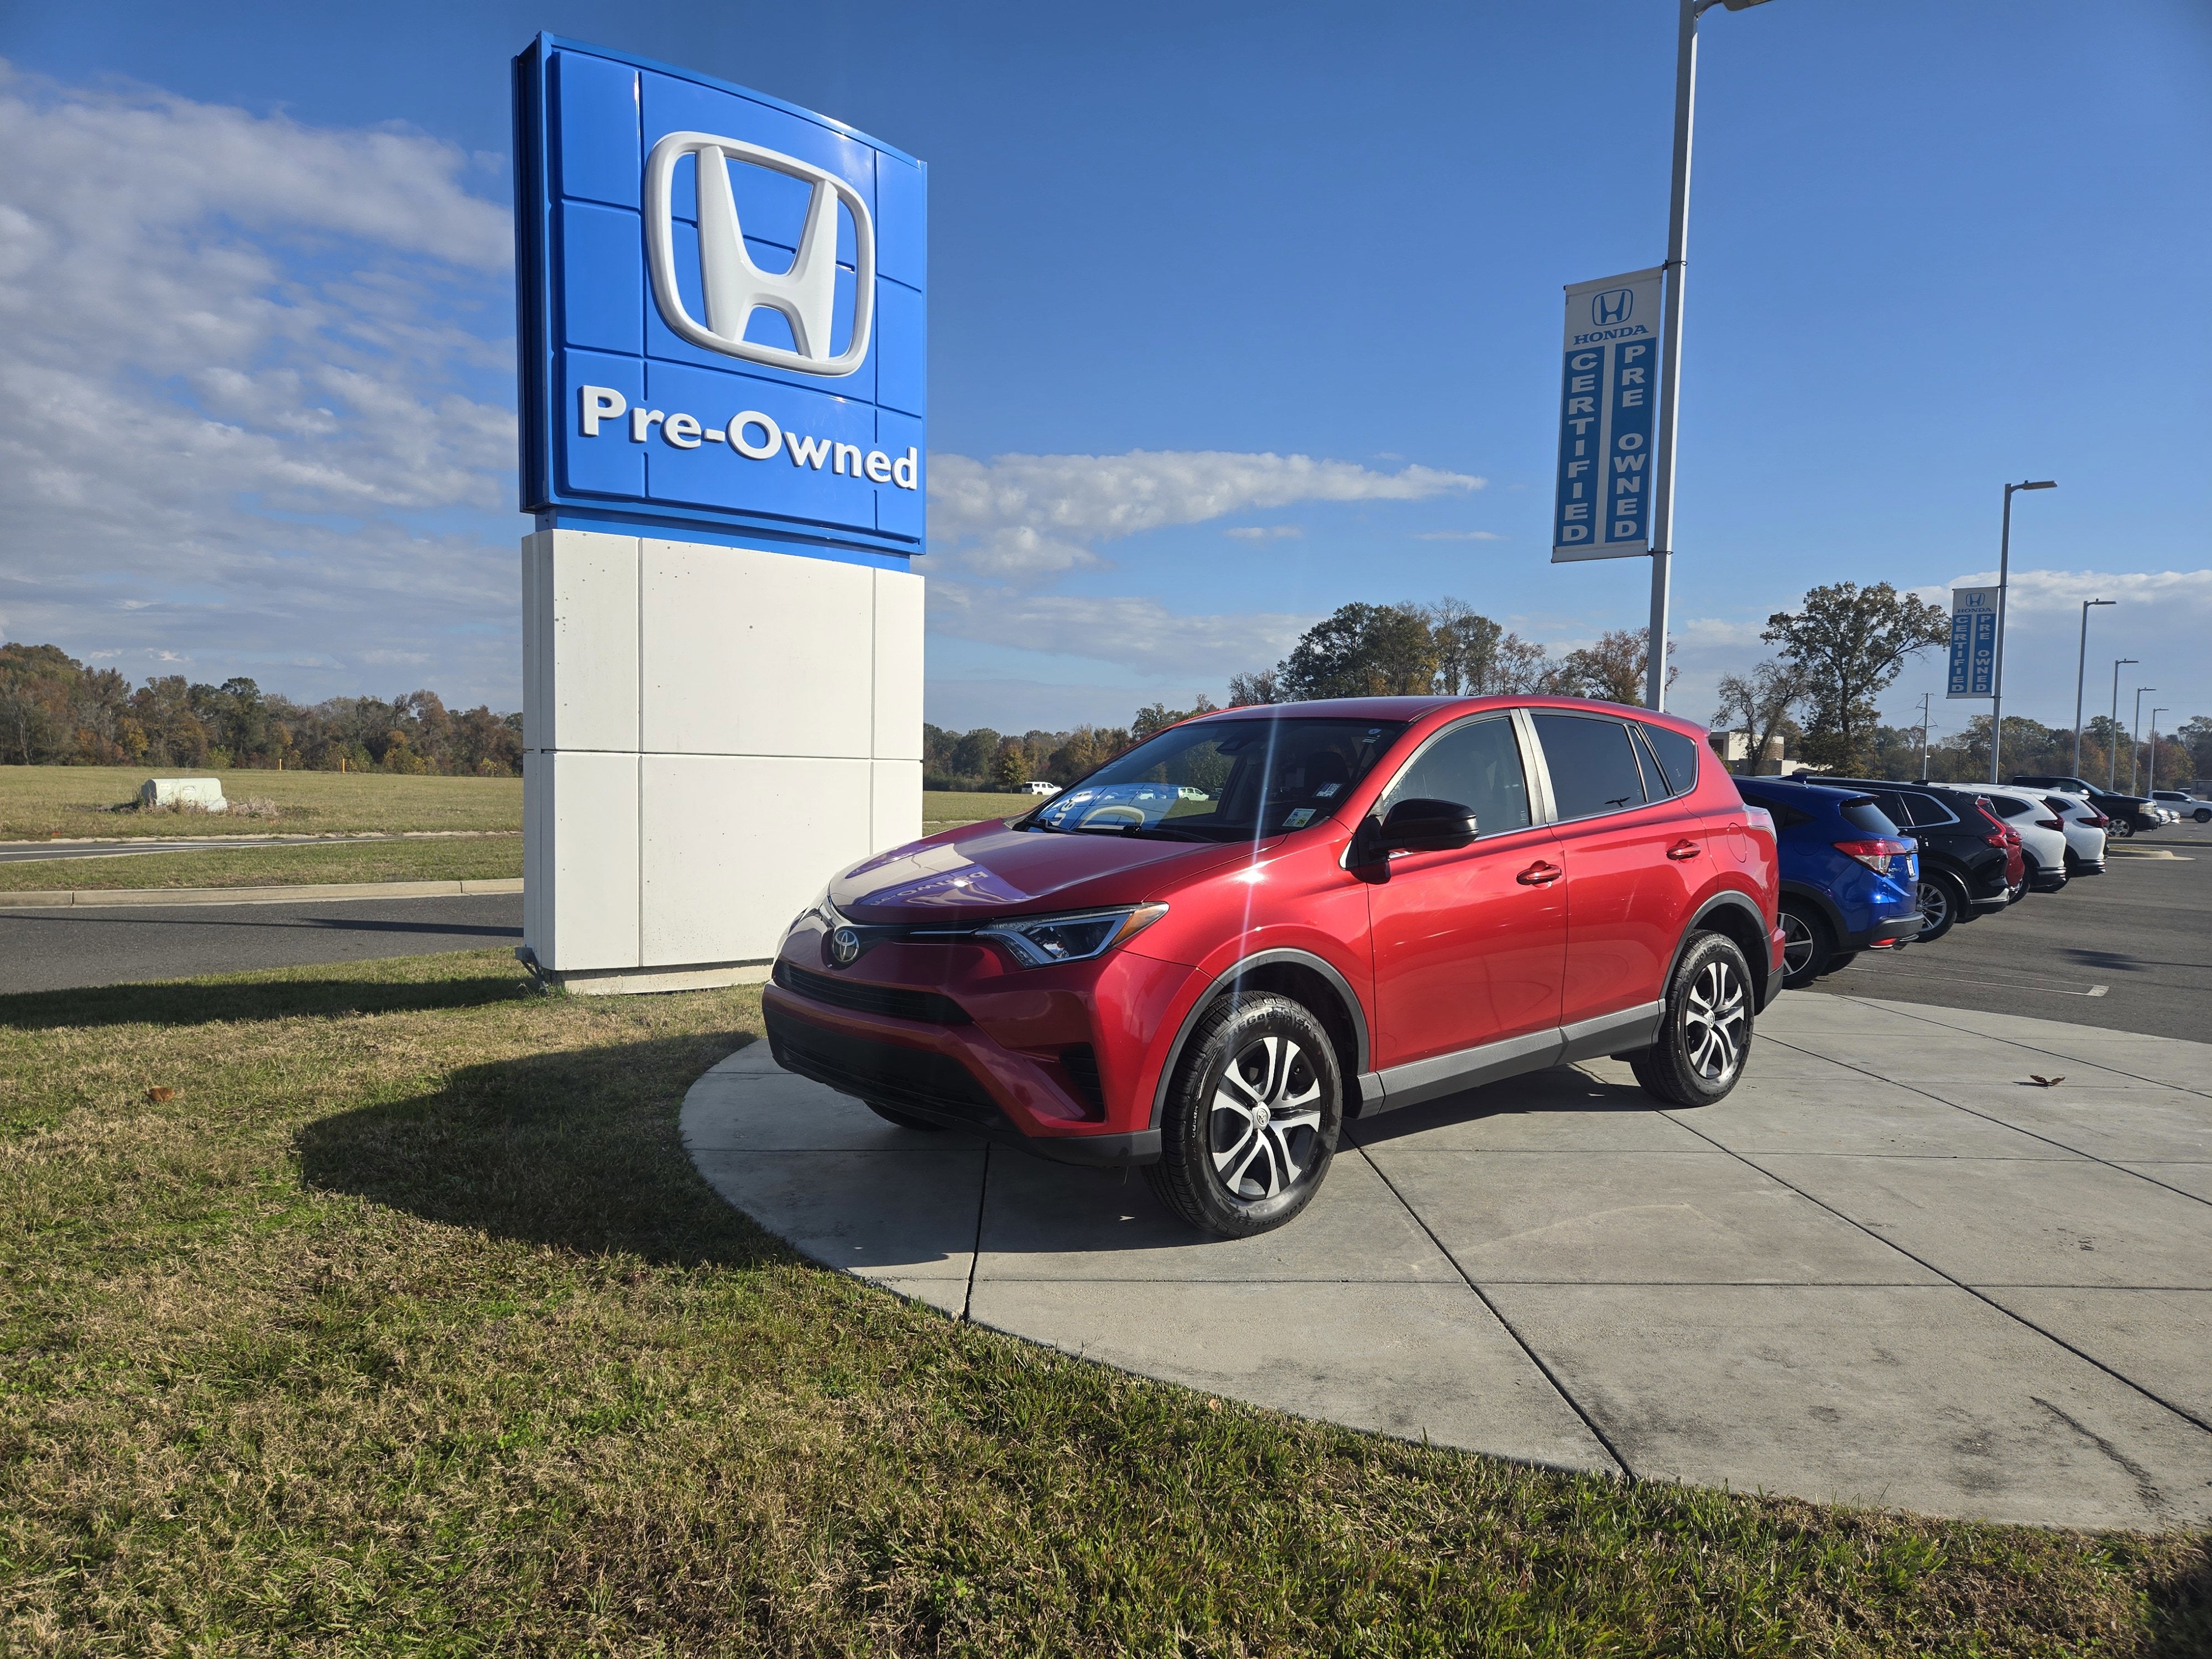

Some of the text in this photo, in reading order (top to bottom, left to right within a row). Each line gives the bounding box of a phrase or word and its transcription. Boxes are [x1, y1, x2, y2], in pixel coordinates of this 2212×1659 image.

[1573, 325, 1649, 345] HONDA
[582, 385, 918, 491] Pre-Owned
[1563, 353, 1598, 542] CERTIFIED
[1614, 345, 1646, 538] PRE OWNED
[1952, 617, 1969, 691] CERTIFIED
[1975, 615, 1991, 691] PRE OWNED
